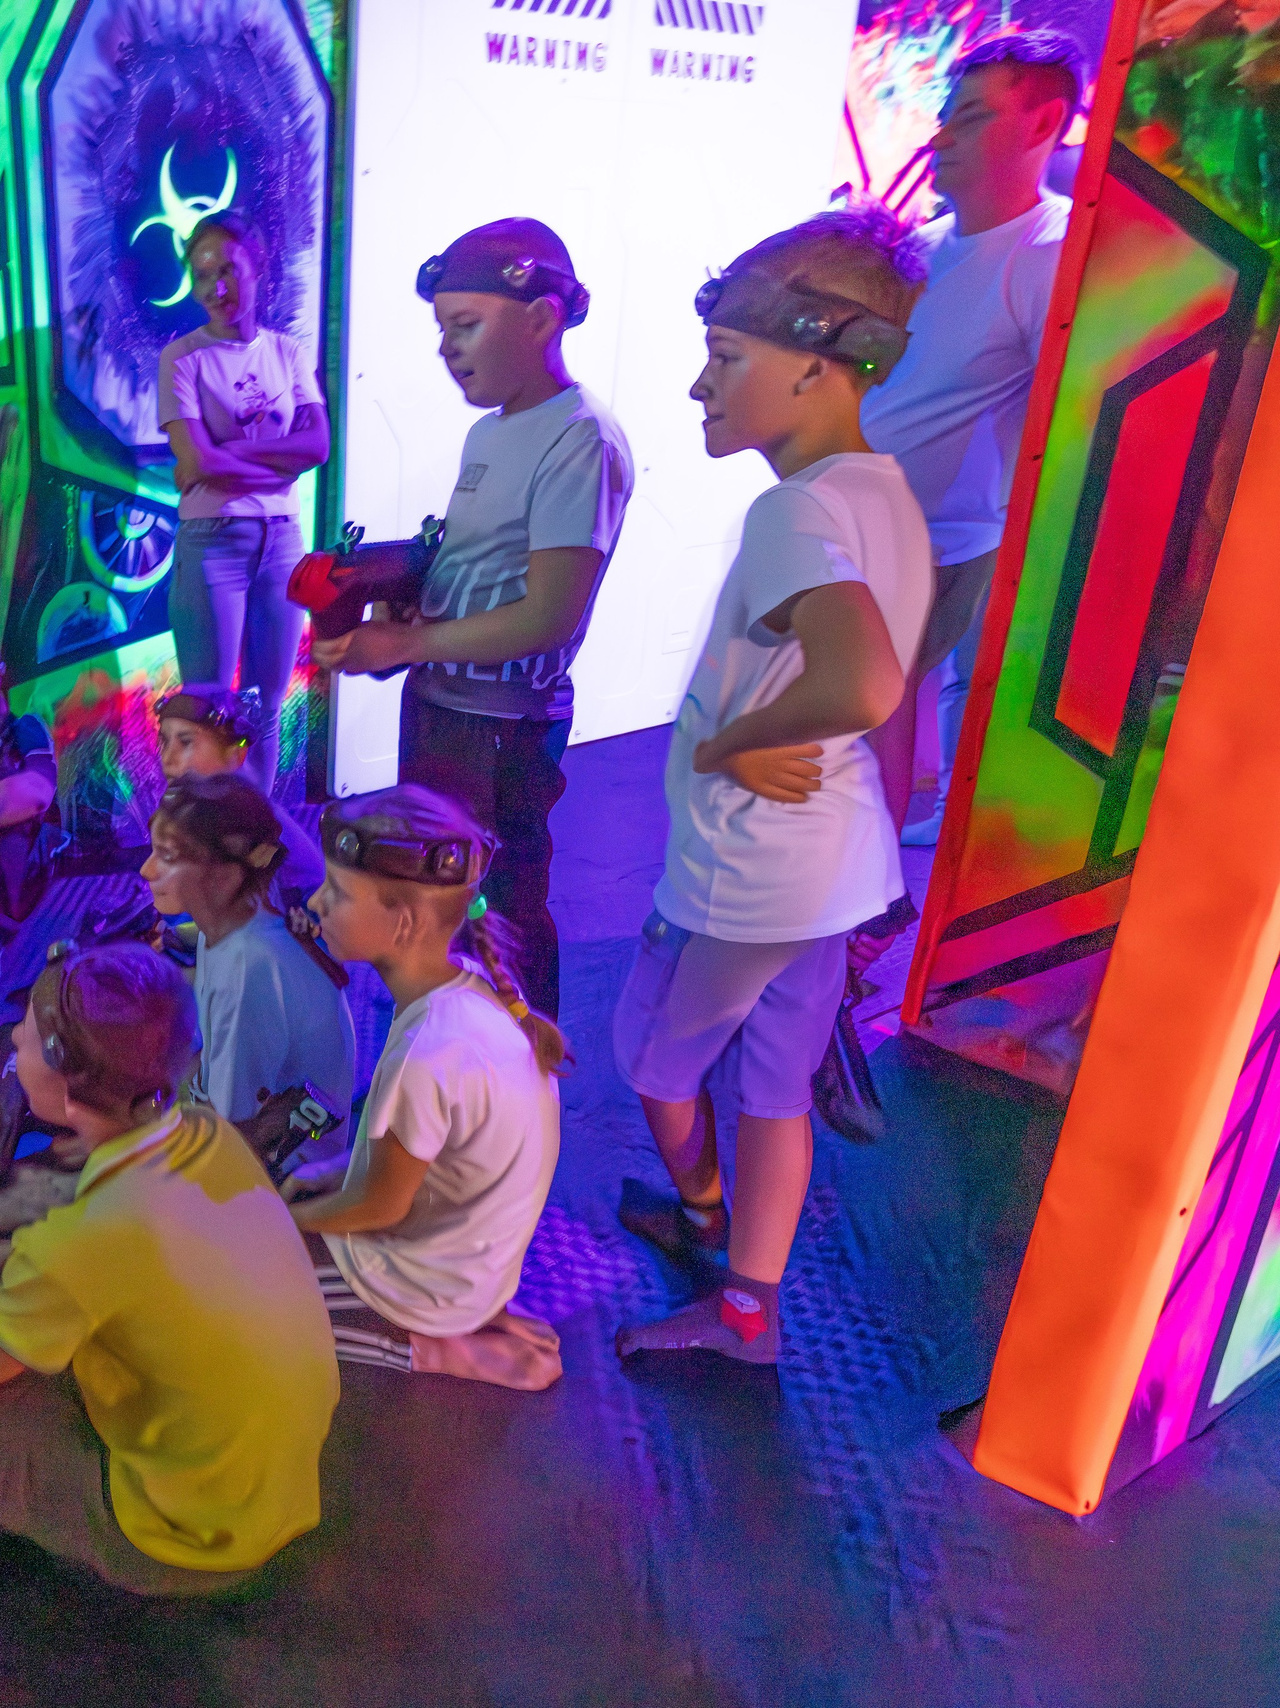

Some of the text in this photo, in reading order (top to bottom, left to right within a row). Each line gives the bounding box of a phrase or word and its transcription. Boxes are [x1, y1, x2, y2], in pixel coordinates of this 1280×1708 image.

[485, 32, 608, 72] WARNING
[650, 48, 755, 83] WARNING
[289, 1097, 328, 1131] 10
